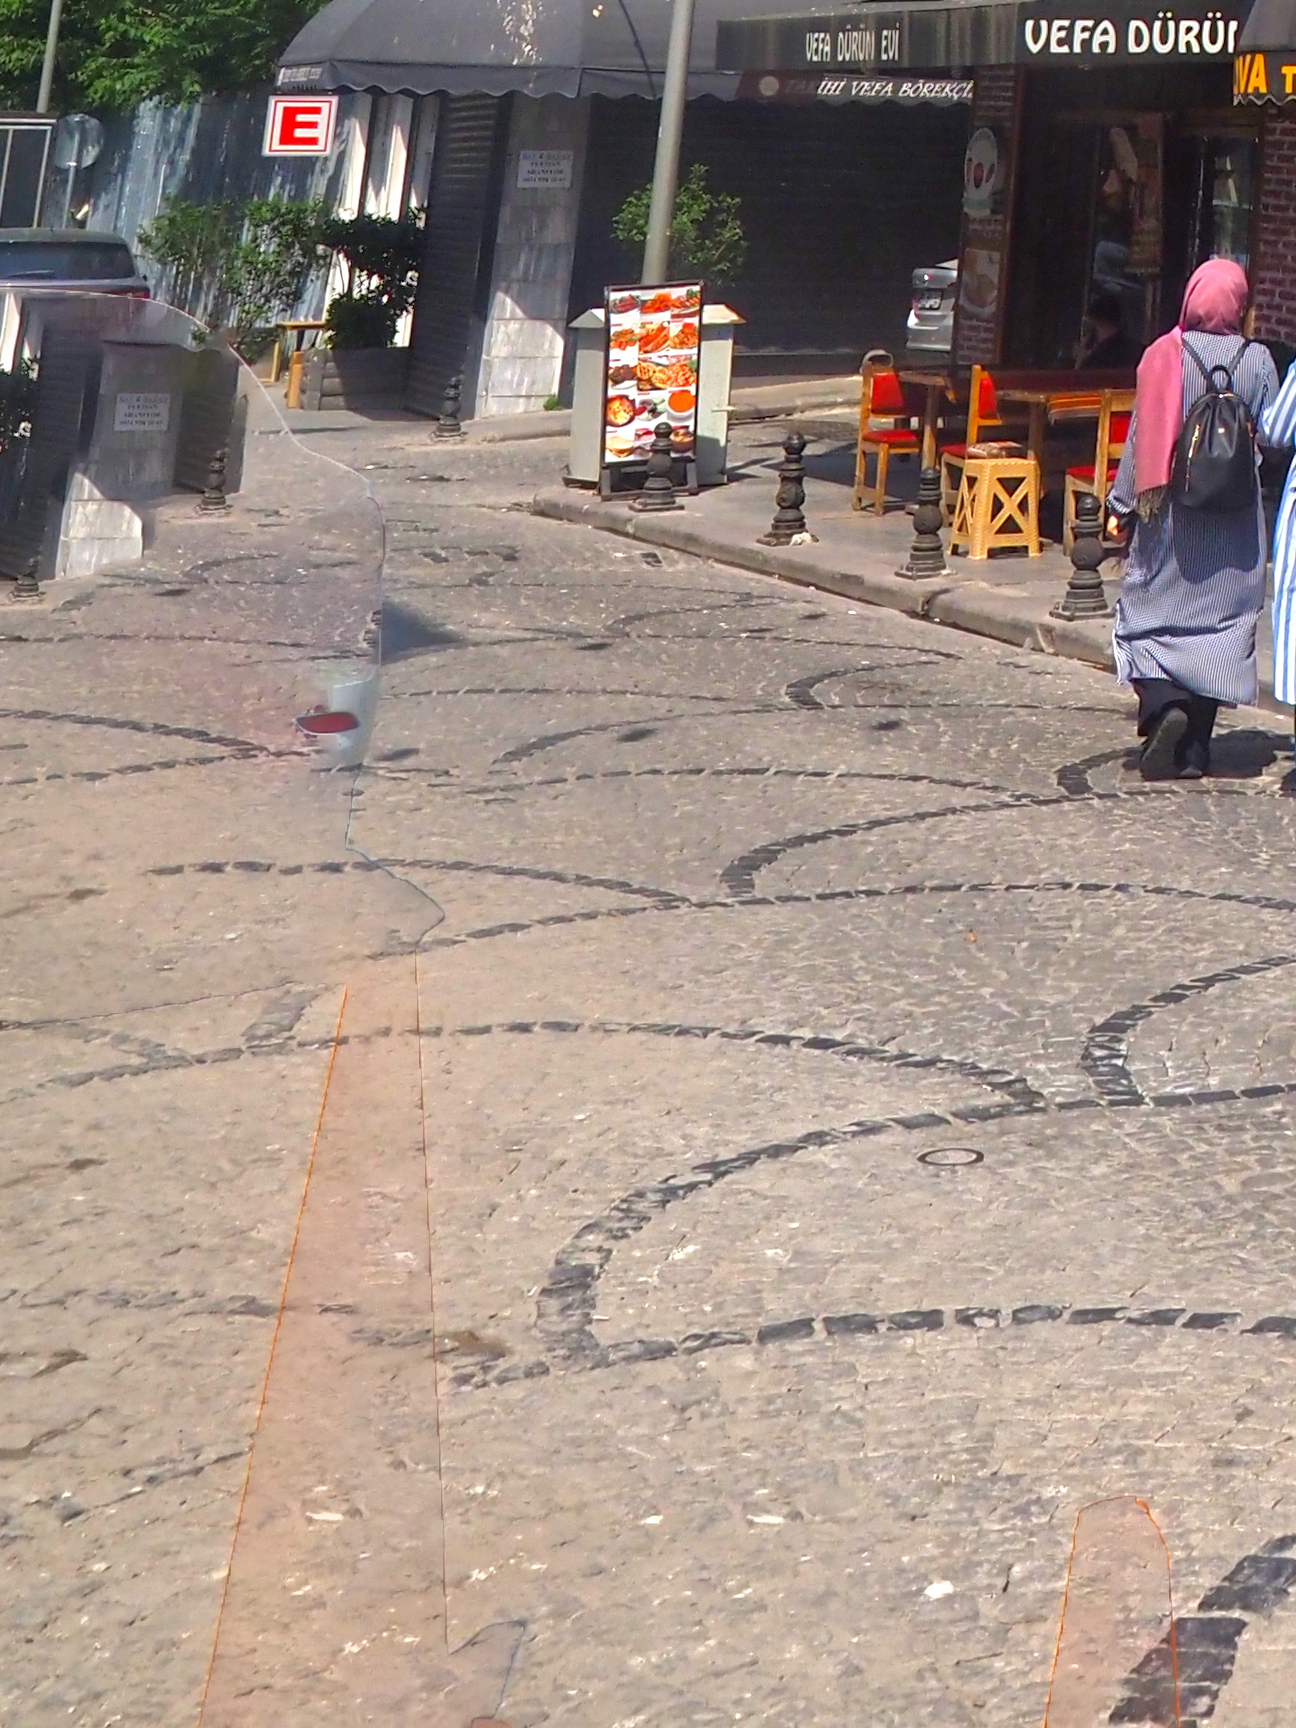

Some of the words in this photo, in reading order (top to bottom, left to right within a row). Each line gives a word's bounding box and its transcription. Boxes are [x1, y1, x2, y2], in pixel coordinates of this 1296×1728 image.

[805, 32, 831, 63] VEFA
[1024, 17, 1117, 55] VEFA
[851, 80, 894, 98] VEFA
[898, 78, 975, 101] BÖREKÇİ
[1233, 53, 1269, 96] VA
[279, 106, 322, 147] E
